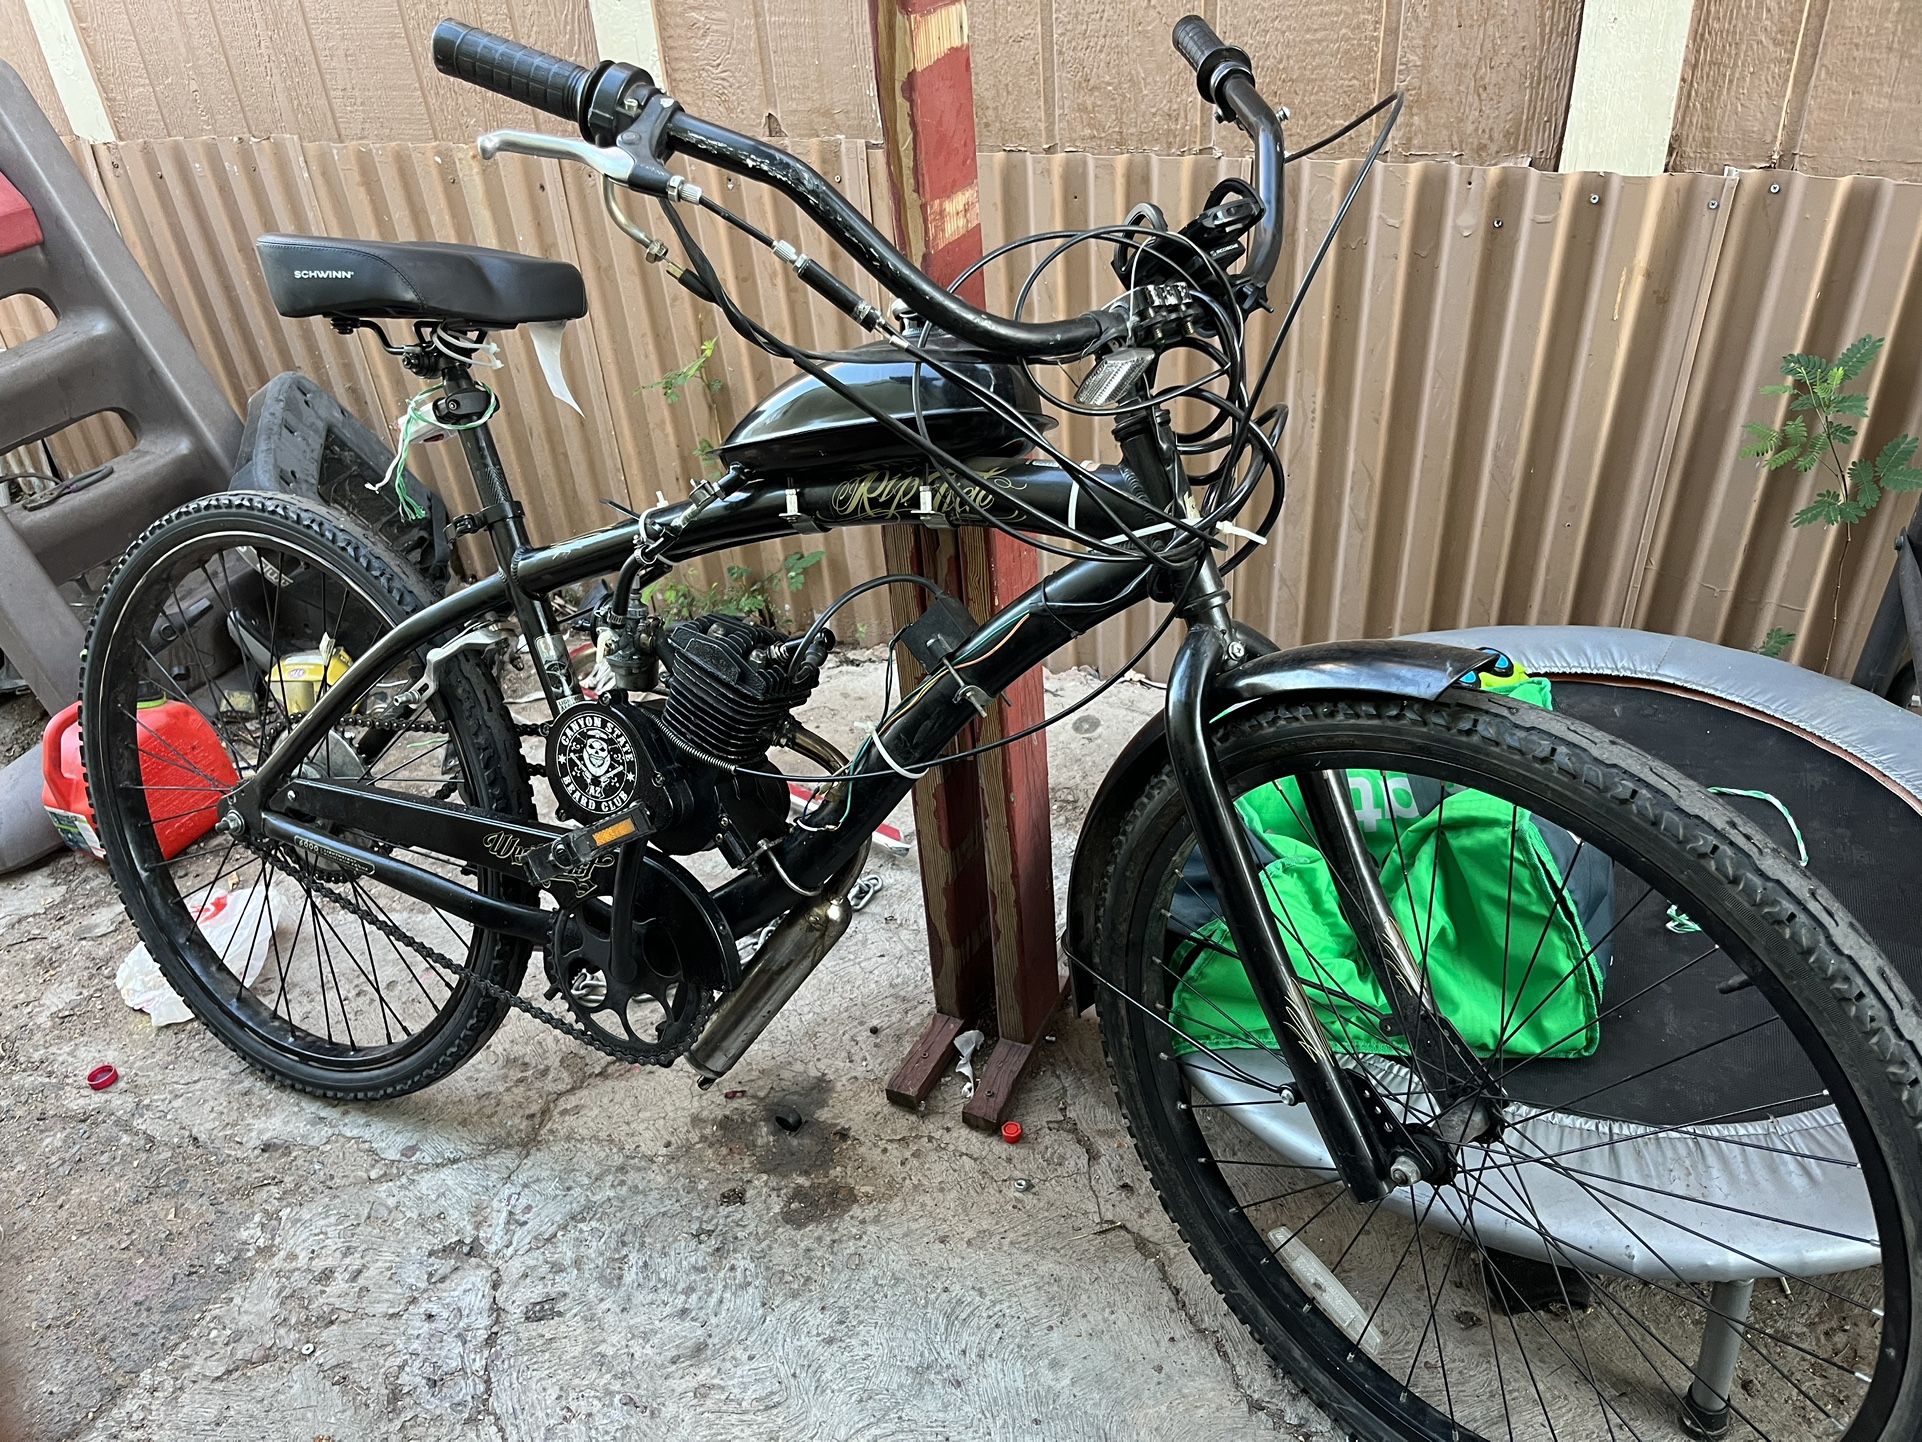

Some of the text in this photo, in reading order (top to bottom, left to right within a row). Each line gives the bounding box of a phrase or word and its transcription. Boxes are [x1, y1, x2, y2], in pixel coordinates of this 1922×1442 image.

[294, 270, 352, 279] SCHWINN
[832, 469, 921, 519] Rip
[561, 716, 634, 762] CANYON STATE
[562, 775, 628, 812] BEARD CLUB
